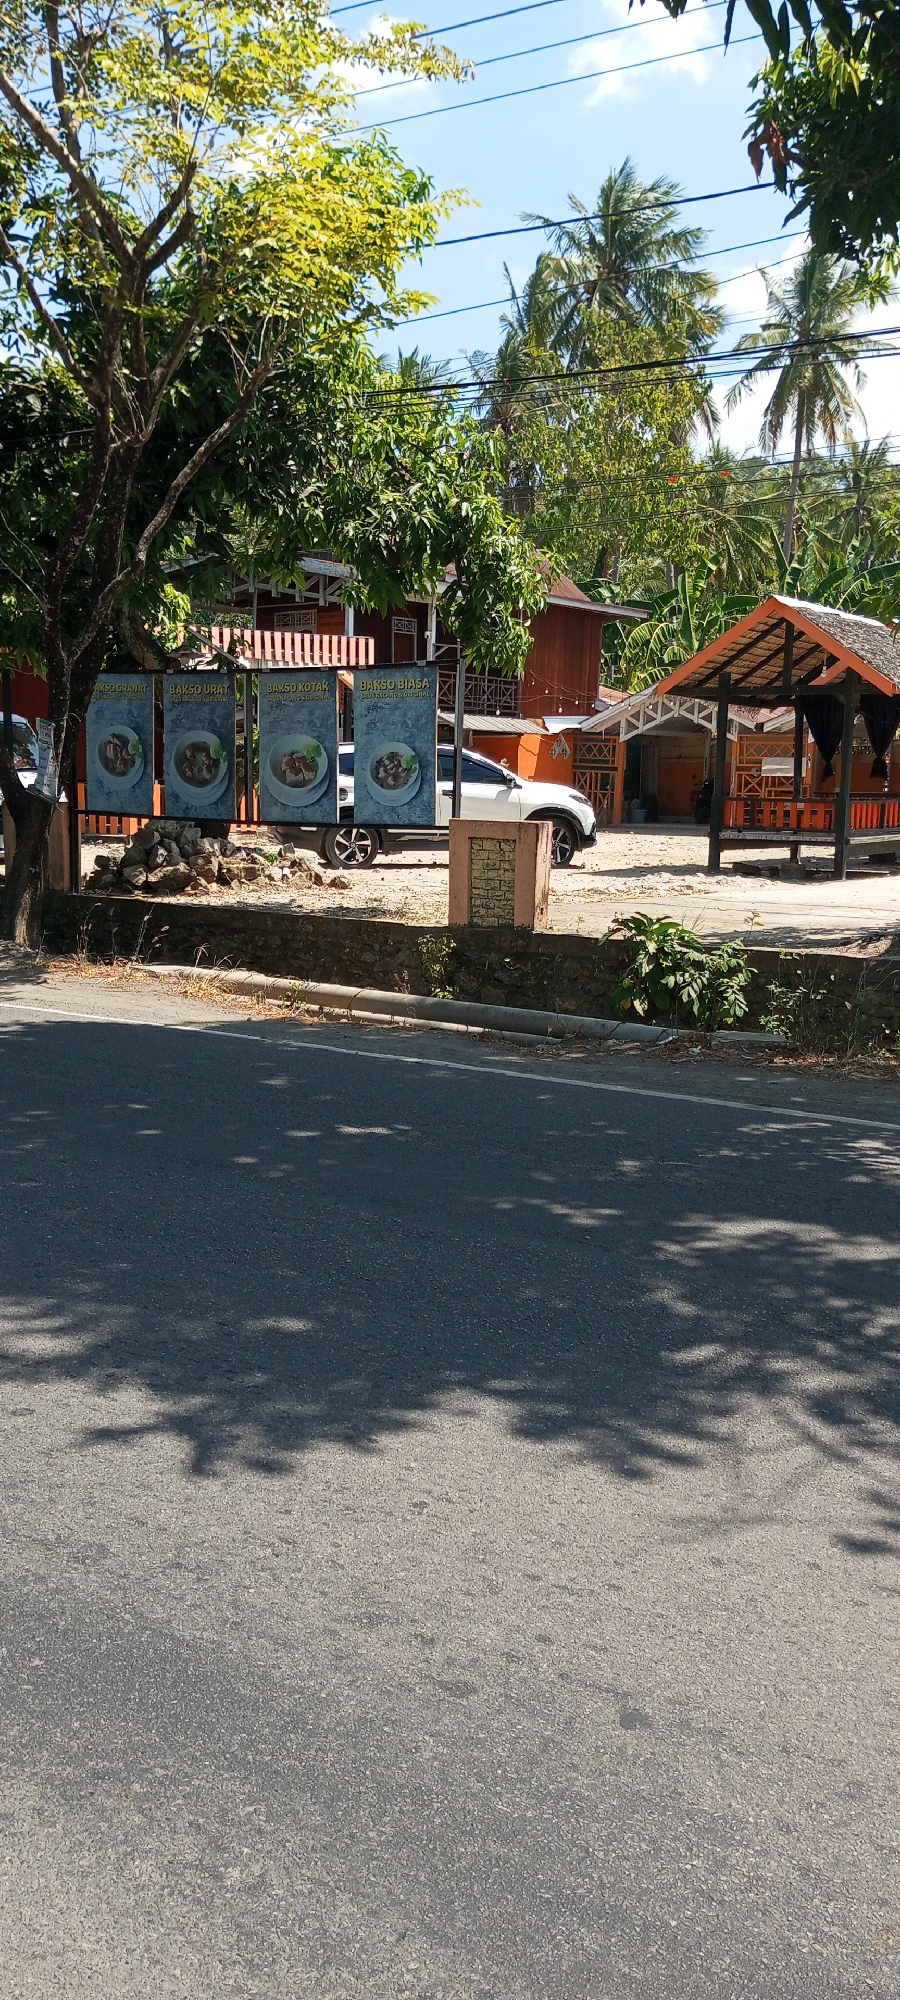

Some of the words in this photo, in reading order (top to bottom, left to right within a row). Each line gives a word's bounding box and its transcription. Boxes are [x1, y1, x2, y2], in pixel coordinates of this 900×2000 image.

[94, 683, 116, 693] AKSO
[117, 683, 148, 693] GRANAT
[170, 684, 202, 695] BAKSO
[203, 684, 230, 695] URAT
[267, 683, 297, 693] BAKSO
[298, 682, 330, 692] KOTAK
[360, 679, 396, 691] BAKSO
[397, 678, 430, 690] BIASA
